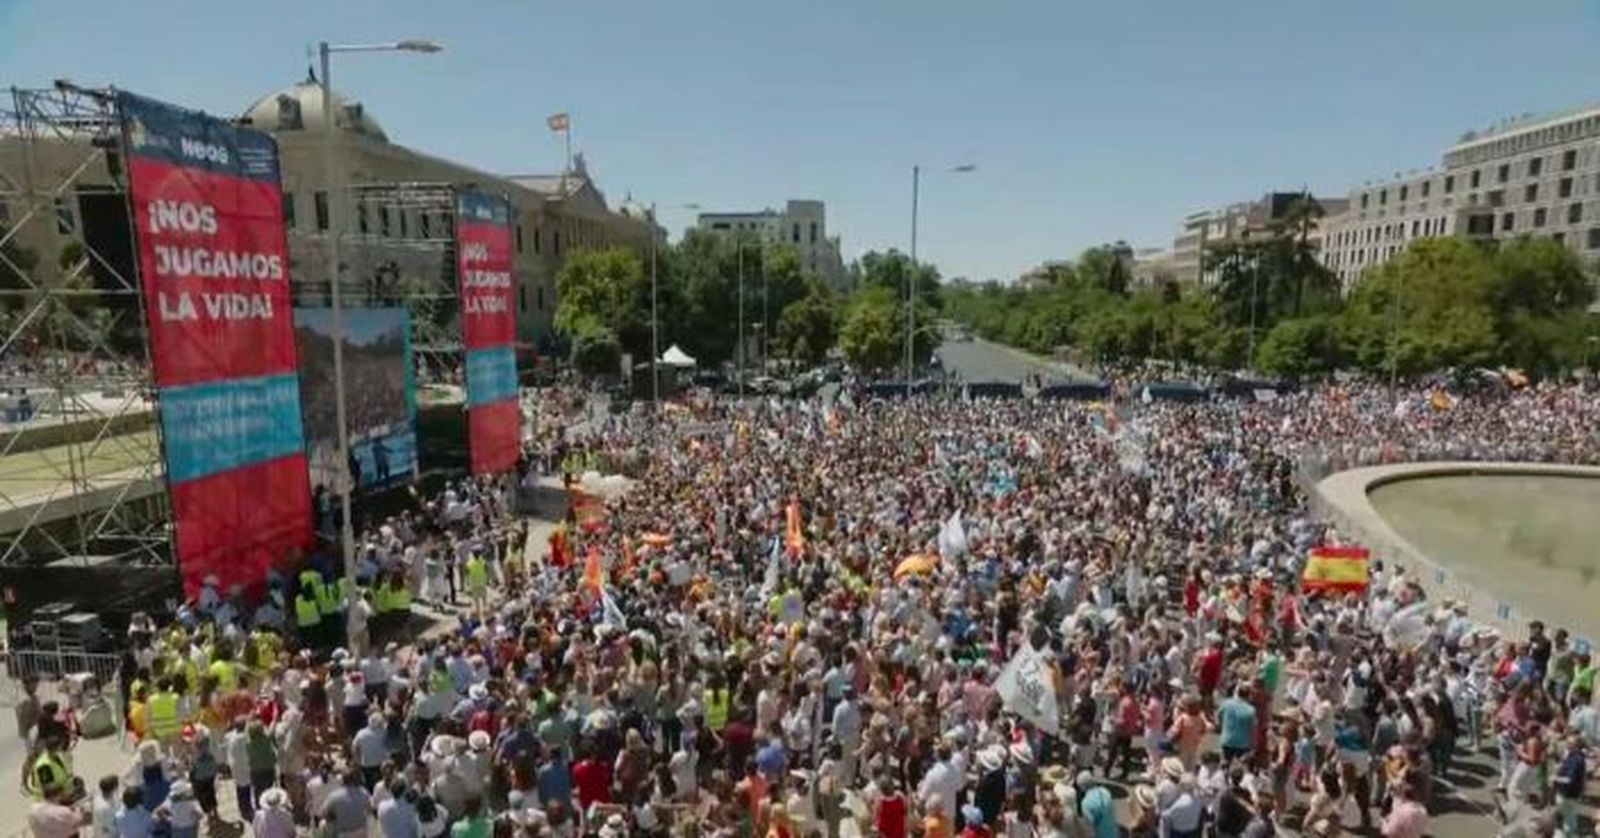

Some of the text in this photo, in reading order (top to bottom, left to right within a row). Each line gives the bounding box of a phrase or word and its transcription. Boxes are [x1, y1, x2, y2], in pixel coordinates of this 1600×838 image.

[149, 200, 218, 234] ¡NOS
[154, 246, 283, 280] JUGAMOS
[159, 291, 273, 322] LA VIDA!
